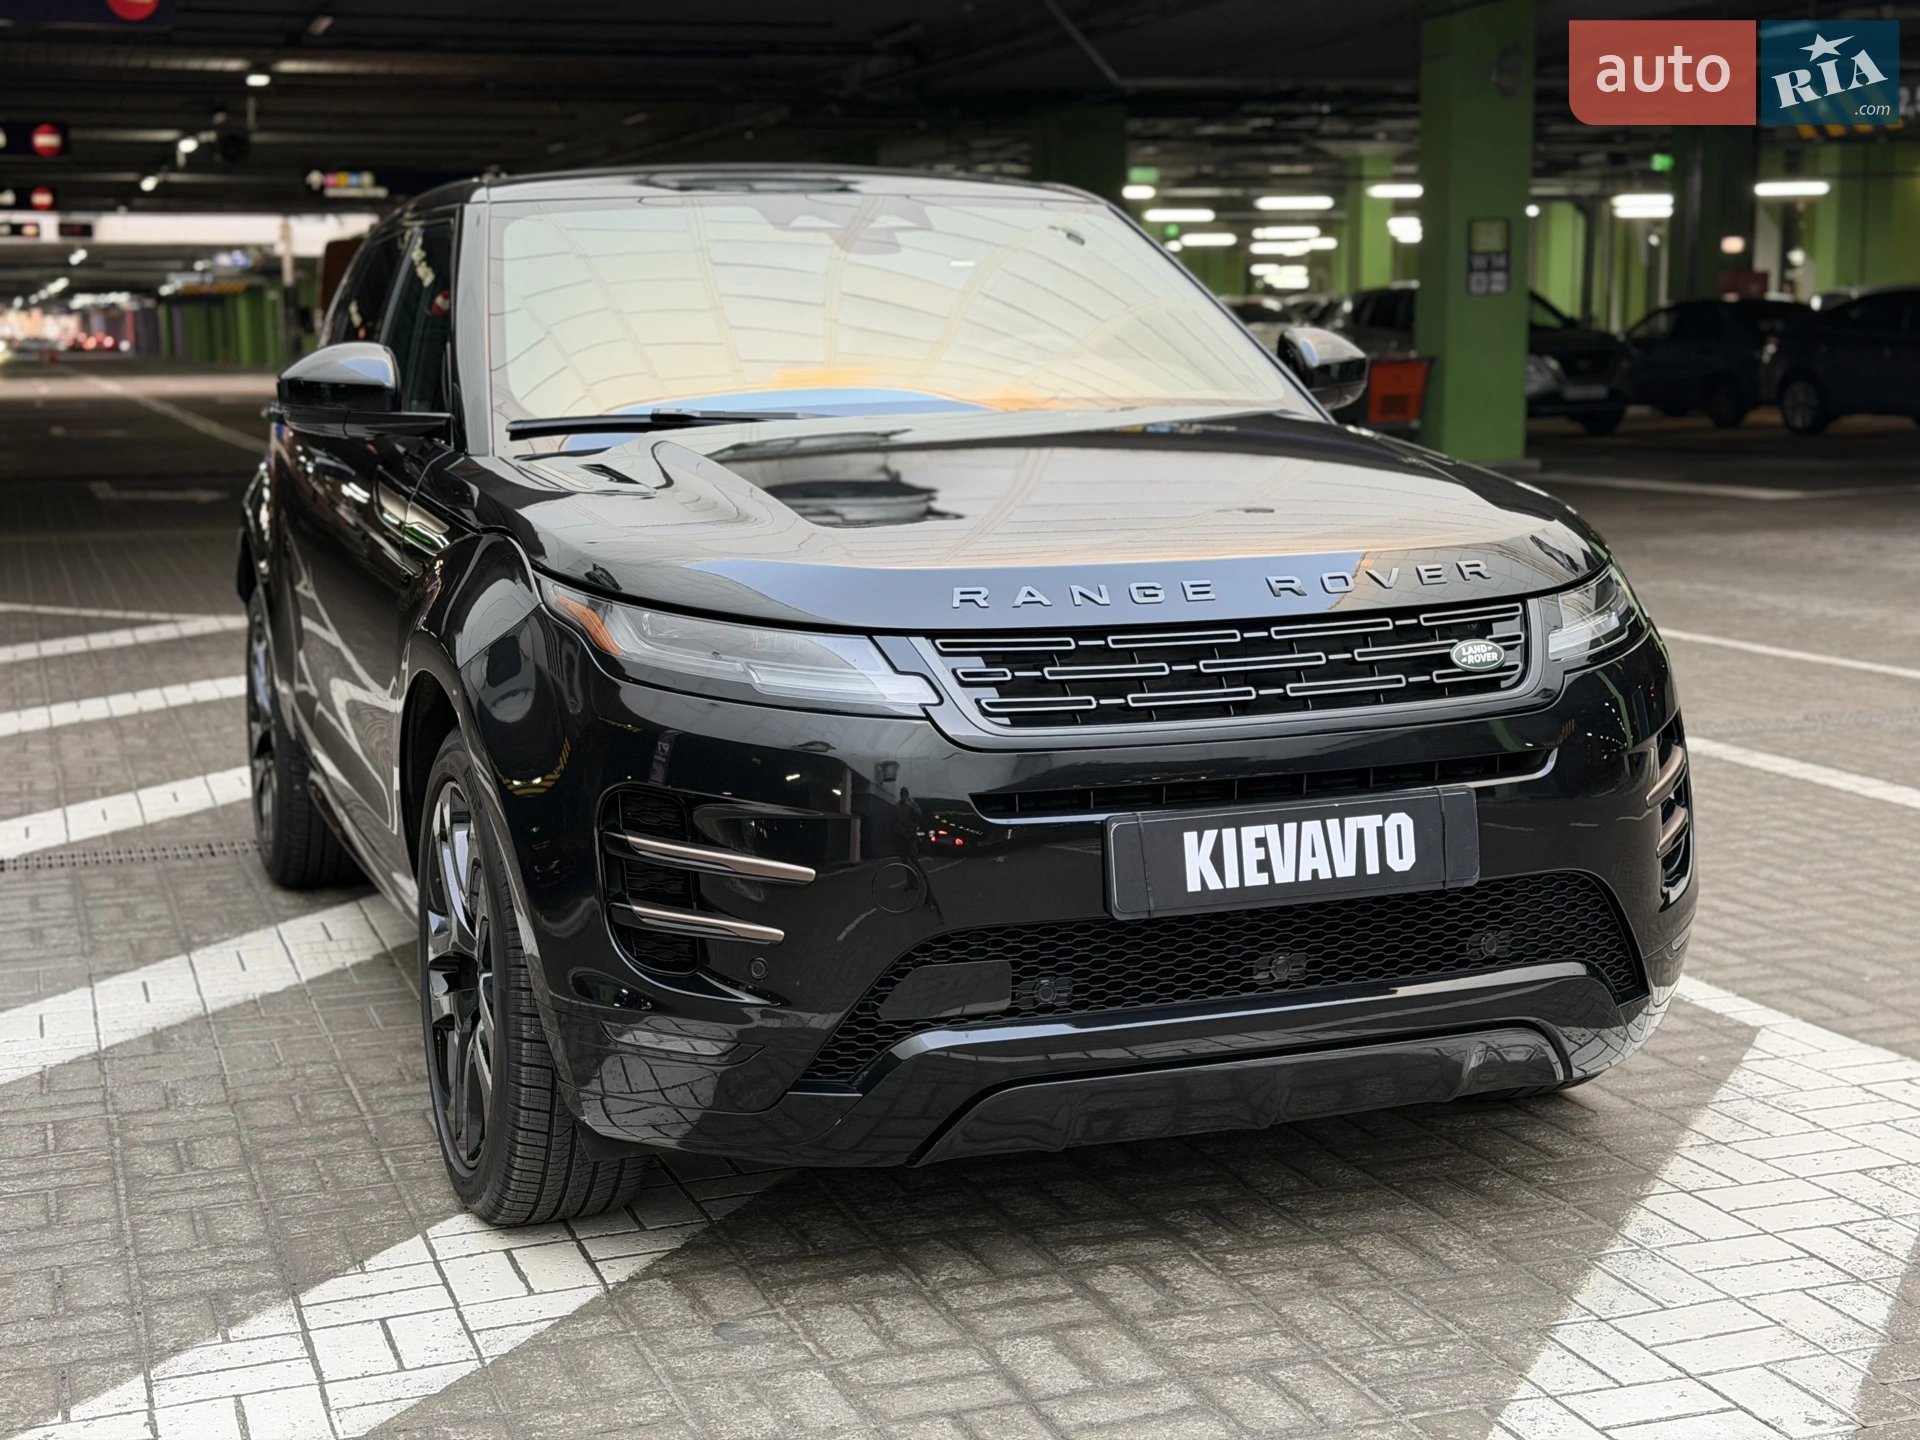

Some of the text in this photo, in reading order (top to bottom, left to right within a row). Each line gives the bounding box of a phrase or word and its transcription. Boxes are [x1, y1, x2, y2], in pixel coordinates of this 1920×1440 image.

[952, 559, 1492, 608] RANGE ROVER
[1461, 644, 1488, 656] LAND
[1467, 652, 1498, 665] ROVER
[1183, 812, 1416, 893] KIEVAVTO
